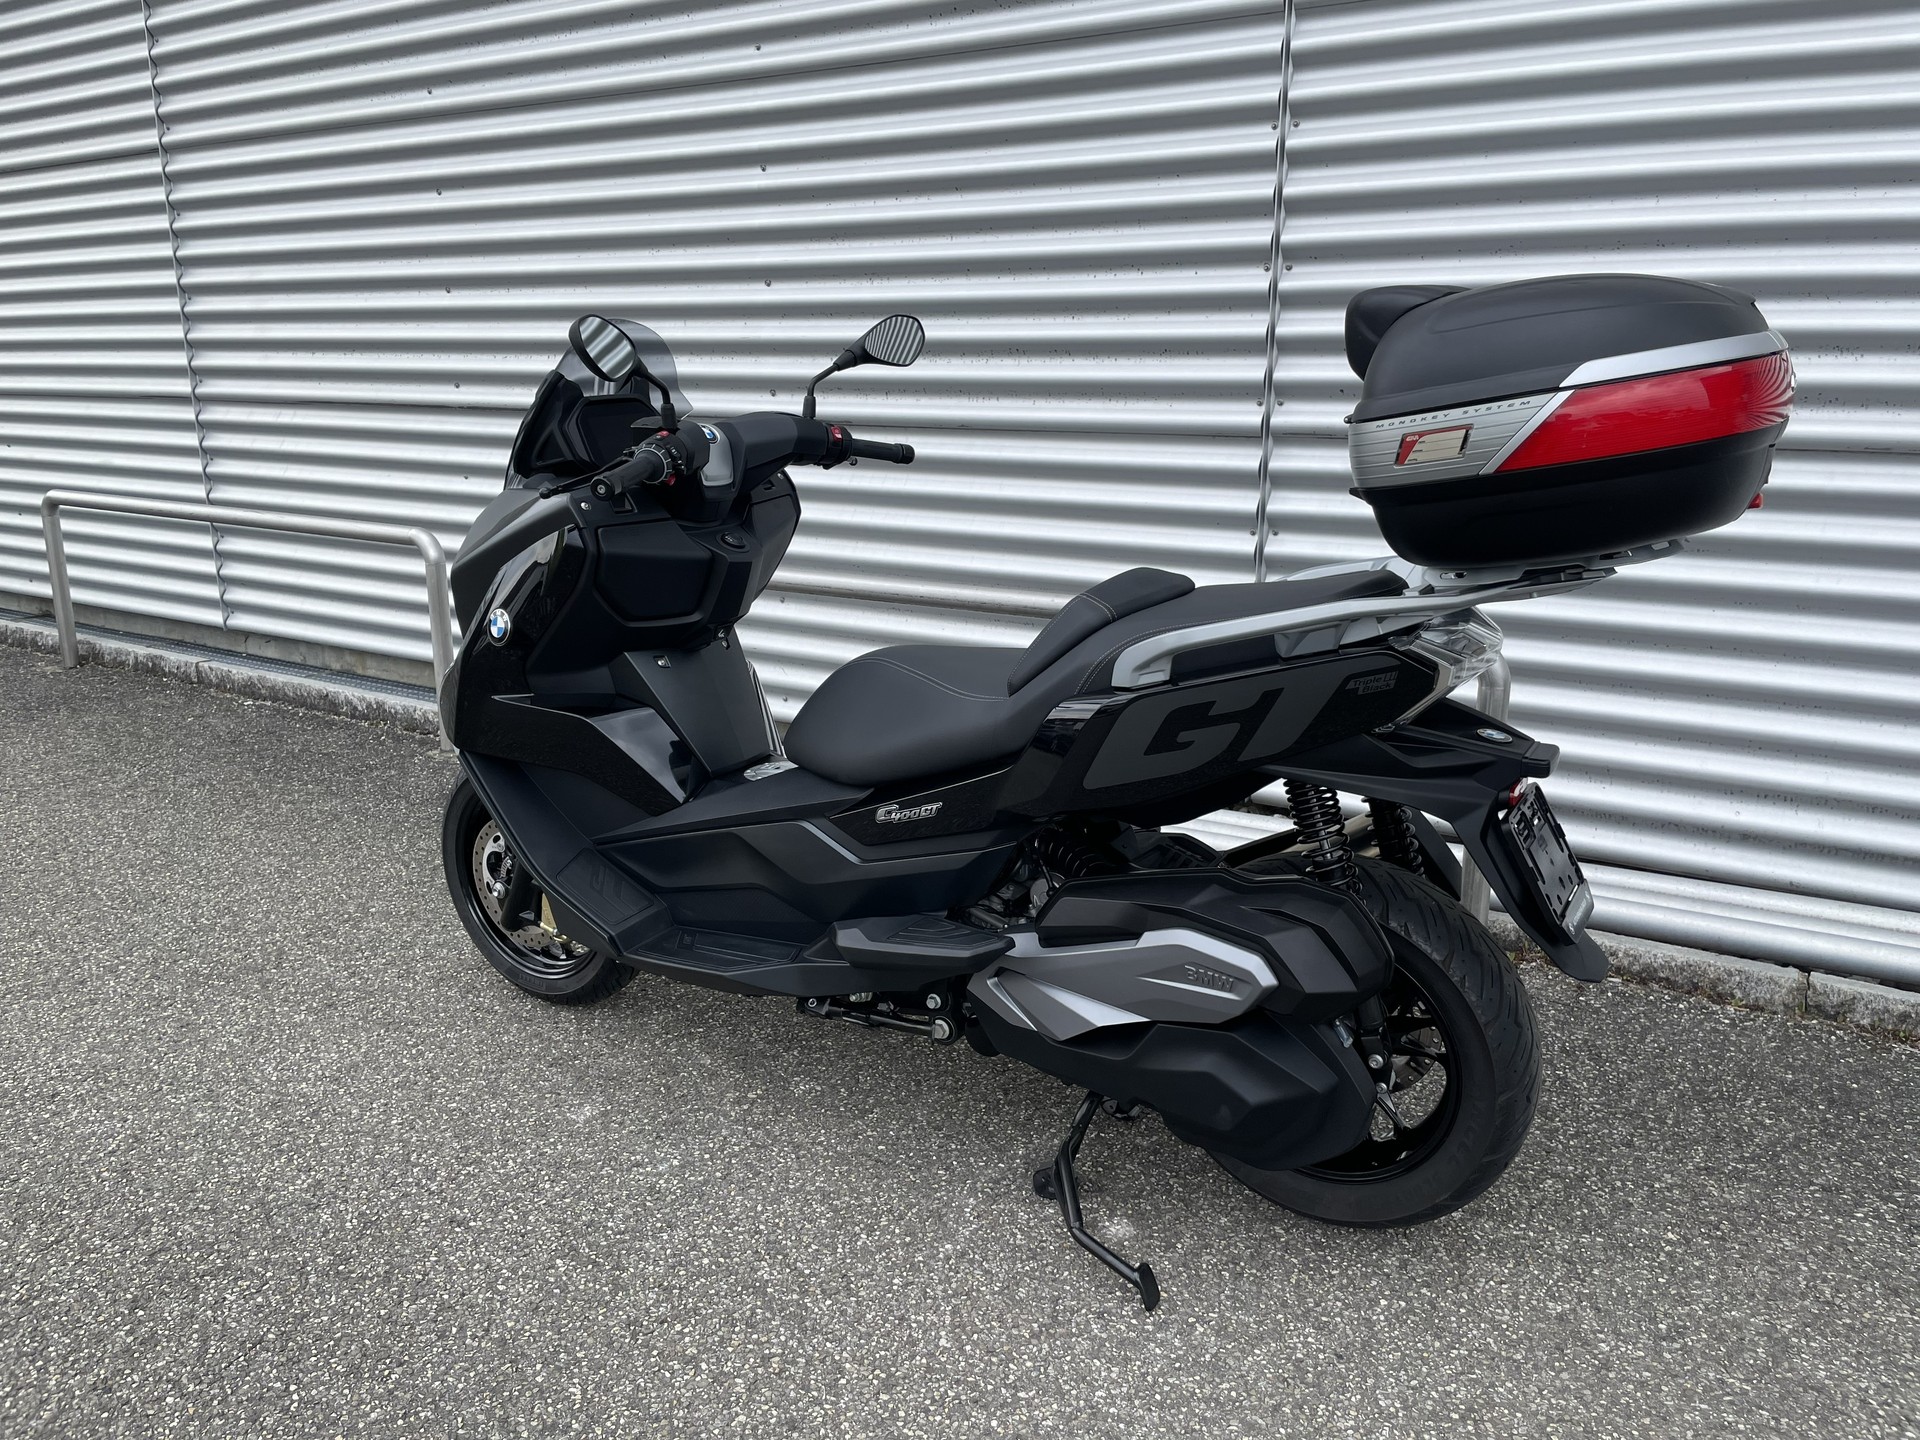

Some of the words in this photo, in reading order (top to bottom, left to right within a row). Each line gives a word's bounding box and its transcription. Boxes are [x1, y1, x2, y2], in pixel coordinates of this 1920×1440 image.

[1375, 412, 1450, 429] MONOKEY
[1461, 400, 1531, 416] SYSTEM
[1352, 676, 1383, 688] Triple
[1362, 682, 1392, 694] Black
[1084, 656, 1370, 790] GT
[1184, 964, 1234, 992] BMW
